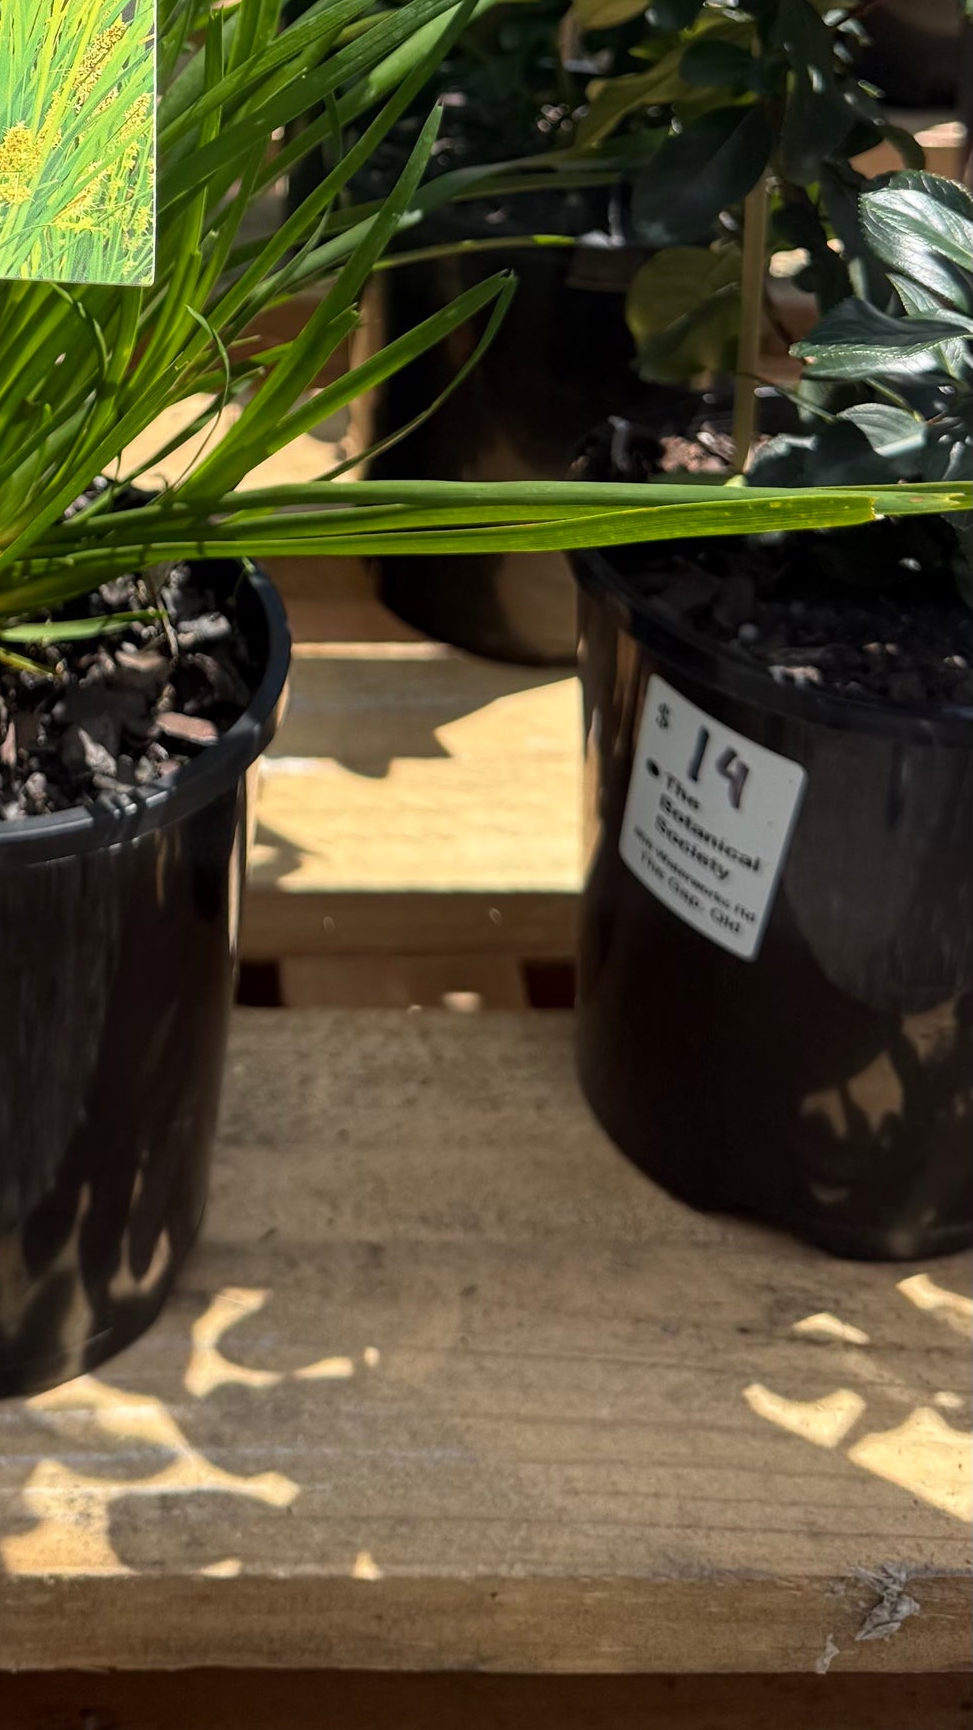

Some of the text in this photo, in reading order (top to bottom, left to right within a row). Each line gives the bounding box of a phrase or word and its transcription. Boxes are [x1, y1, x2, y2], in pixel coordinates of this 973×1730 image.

[655, 702, 750, 810] $ 14
[664, 773, 700, 810] The
[654, 814, 729, 880] Society
[659, 792, 761, 872] Botanical
